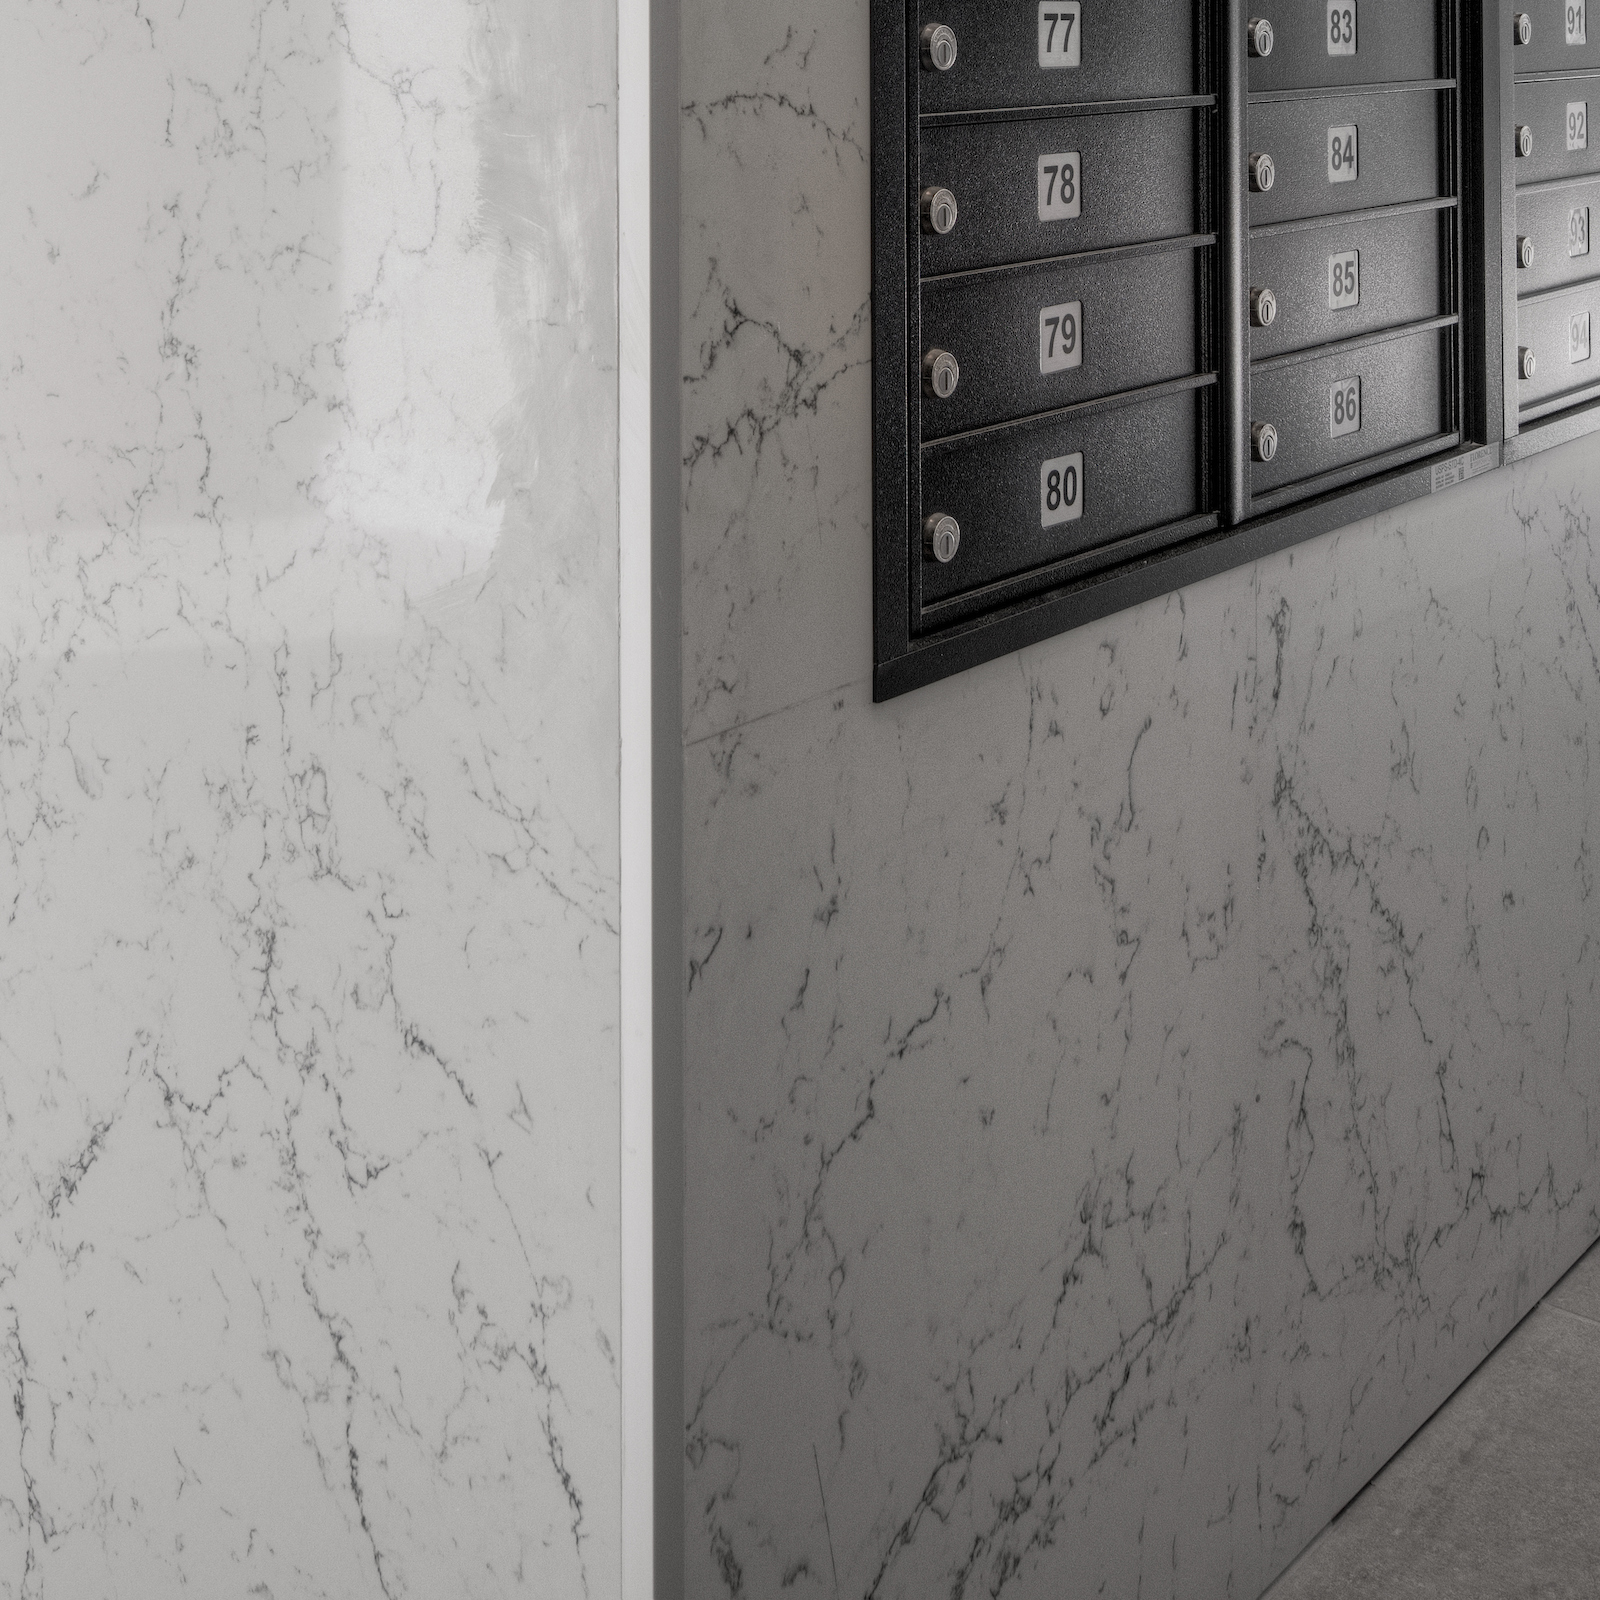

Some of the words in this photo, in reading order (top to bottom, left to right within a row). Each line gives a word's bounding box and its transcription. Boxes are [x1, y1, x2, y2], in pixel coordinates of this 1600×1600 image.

[1043, 12, 1075, 54] 77
[1329, 8, 1353, 46] 83
[1567, 4, 1583, 34] 91
[1568, 111, 1585, 141] 92
[1330, 134, 1354, 172] 84
[1043, 163, 1075, 207] 78
[1569, 215, 1586, 246] 93
[1331, 258, 1355, 297] 85
[1044, 312, 1076, 358] 79
[1571, 320, 1588, 352] 94
[1333, 385, 1357, 426] 86
[1045, 464, 1078, 511] 80
